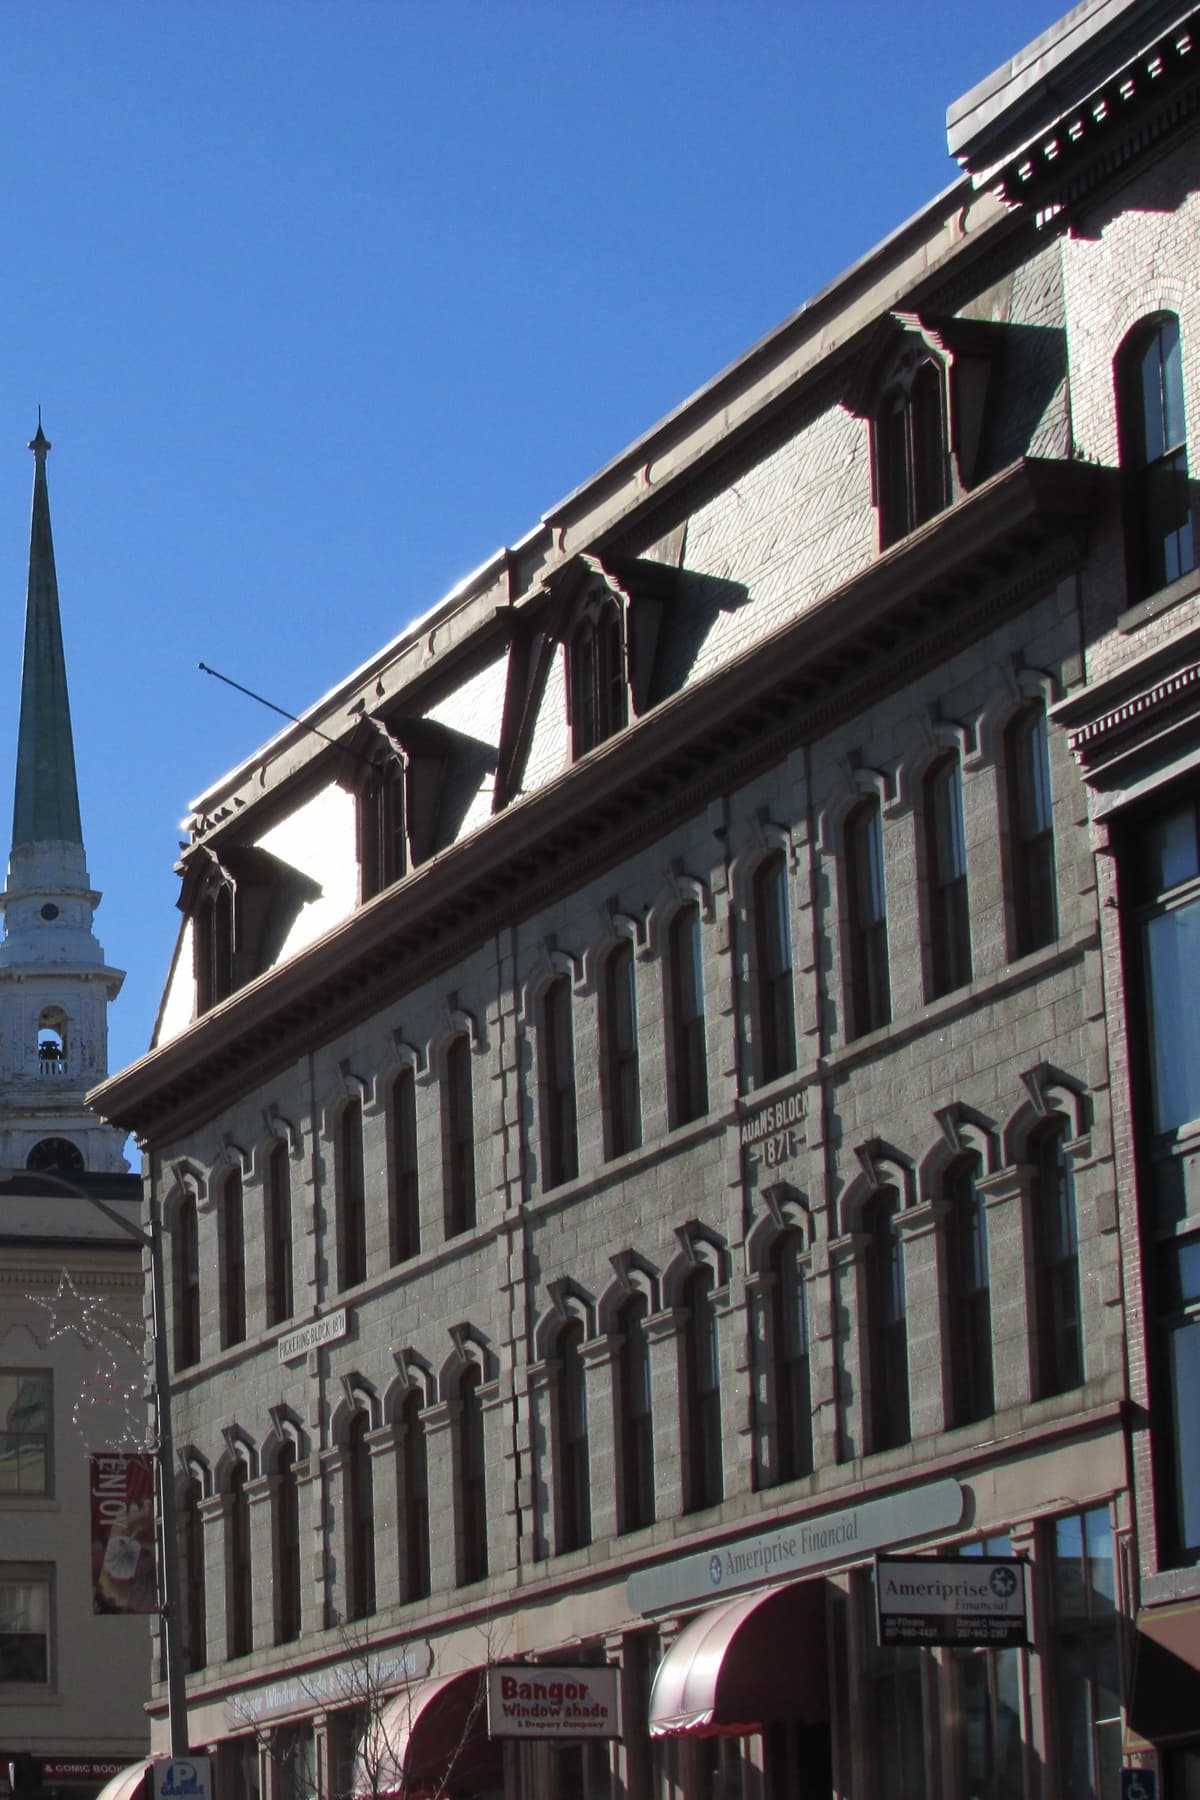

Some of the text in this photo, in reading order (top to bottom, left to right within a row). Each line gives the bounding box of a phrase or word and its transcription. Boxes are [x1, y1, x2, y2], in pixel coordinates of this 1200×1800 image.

[741, 1089, 809, 1145] ADAMS BLOCK
[279, 1329, 310, 1359] PICKERING
[310, 1319, 331, 1344] BLOCK
[92, 1458, 128, 1528] ENJOY
[726, 1511, 858, 1576] Ameriprise Financial
[885, 1579, 989, 1601] Ameriprise
[954, 1599, 1008, 1610] Financial
[265, 1680, 298, 1709] Window
[501, 1675, 589, 1706] Bangor
[502, 1703, 561, 1718] Window
[563, 1720, 605, 1729] Company
[55, 1764, 90, 1773] COMIC
[173, 1763, 195, 1787] P
